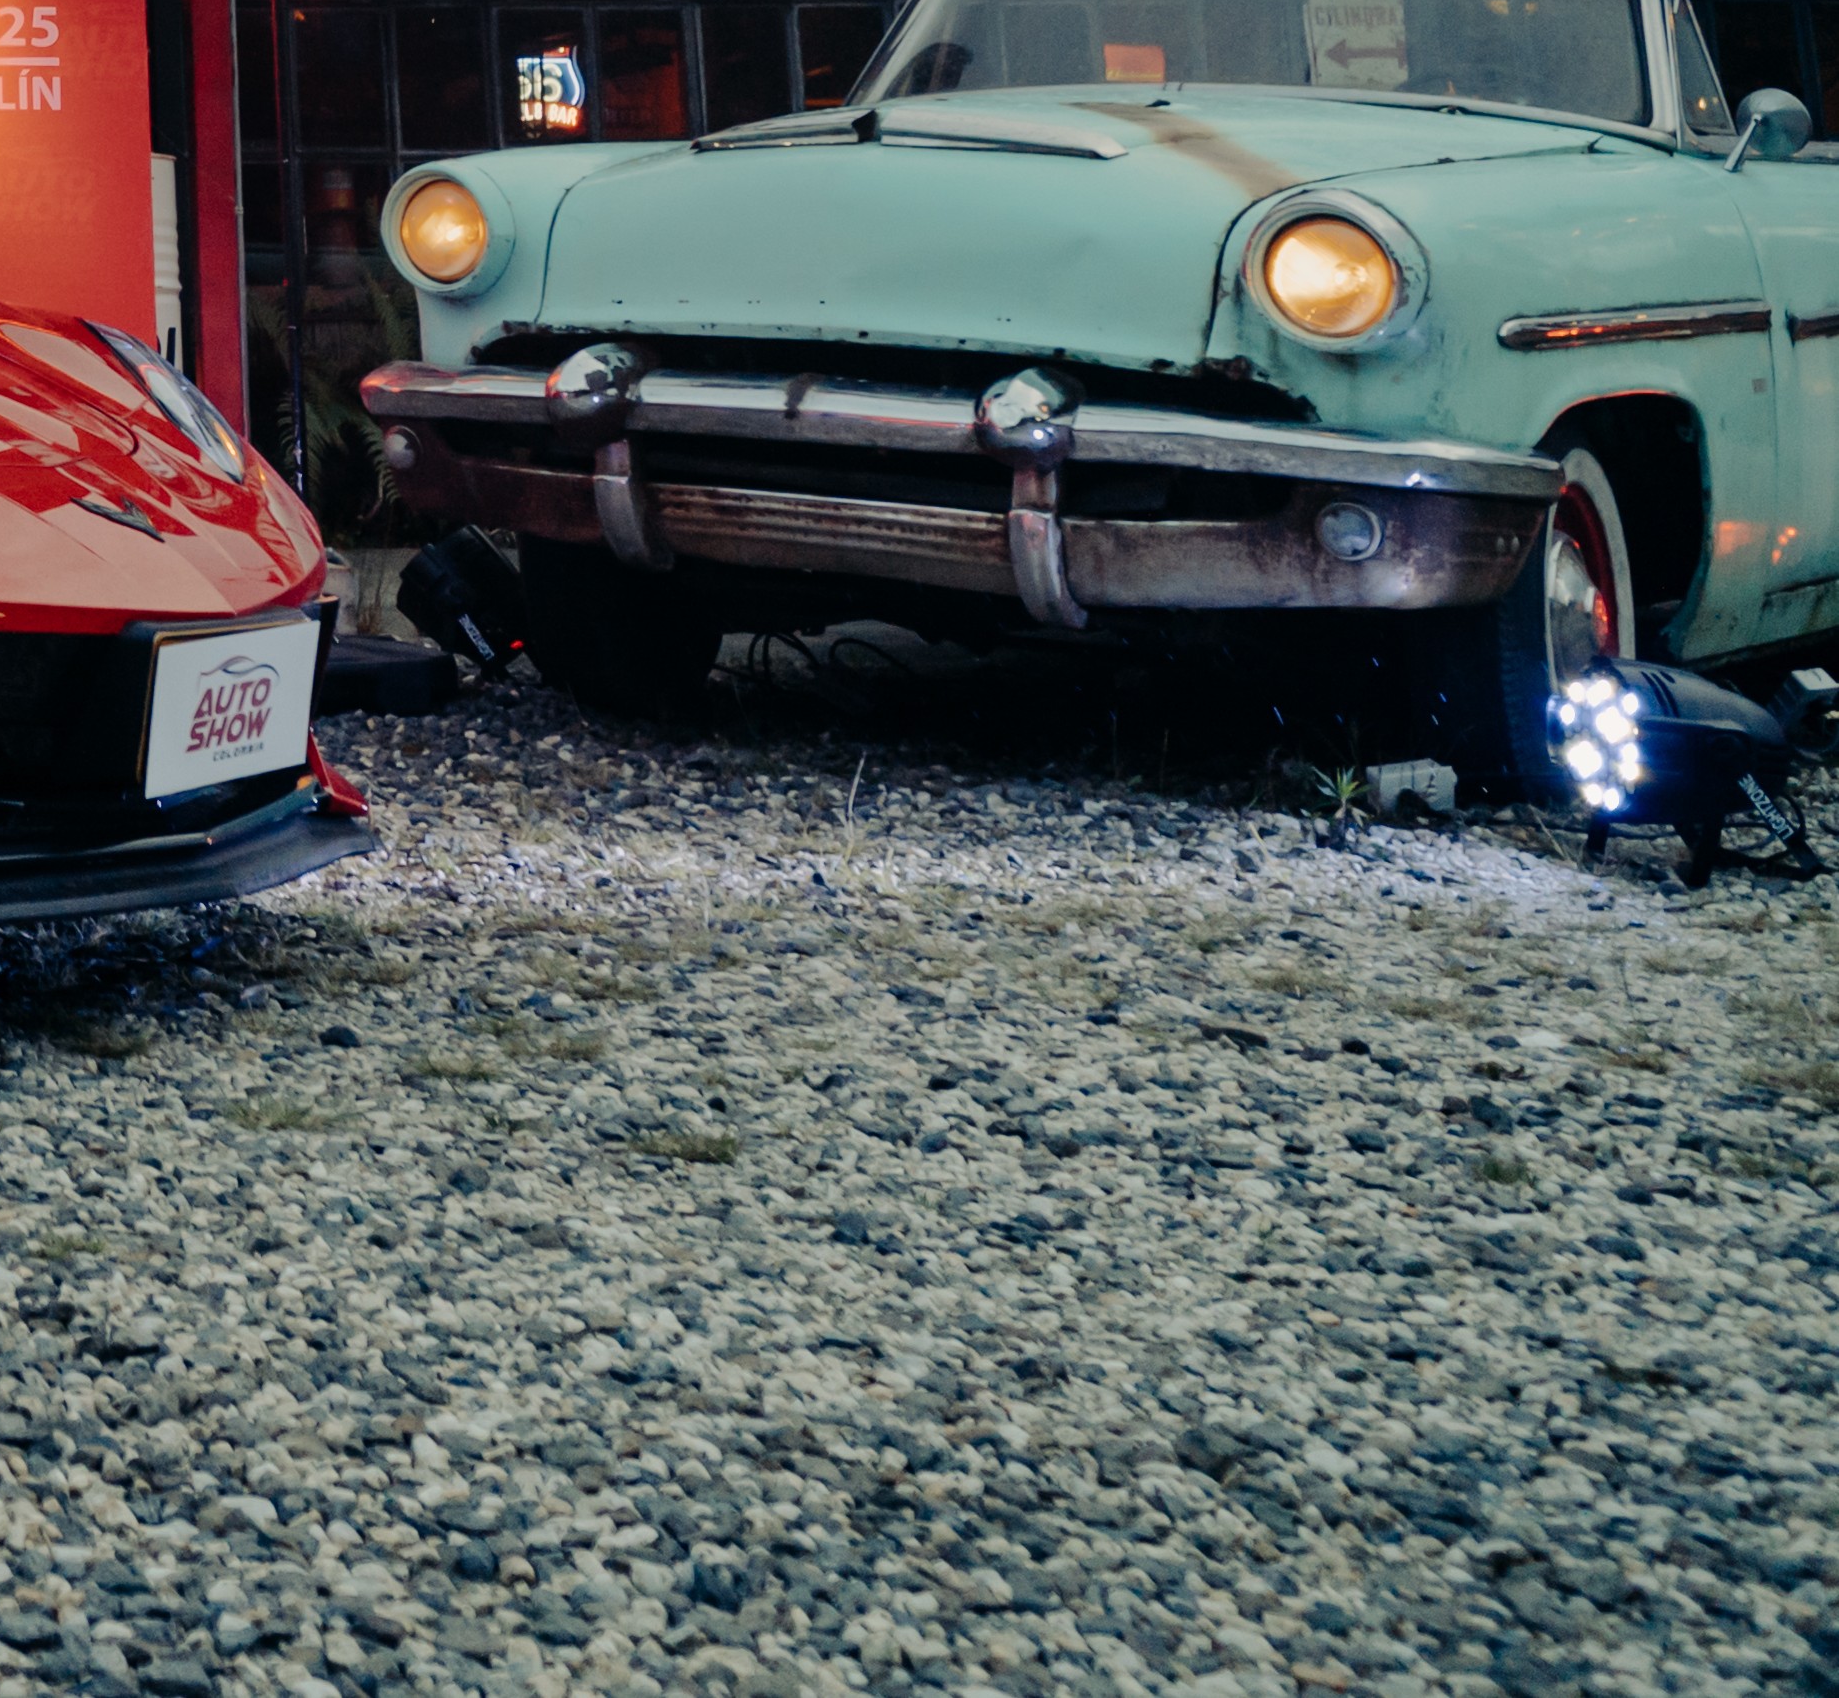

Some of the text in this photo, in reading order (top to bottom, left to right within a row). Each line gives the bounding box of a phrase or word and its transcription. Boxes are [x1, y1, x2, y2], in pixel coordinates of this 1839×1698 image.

[548, 104, 579, 127] BAR
[193, 677, 272, 720] AUTO
[186, 708, 272, 753] SHOW
[1737, 773, 1795, 840] LIGHTZONE
